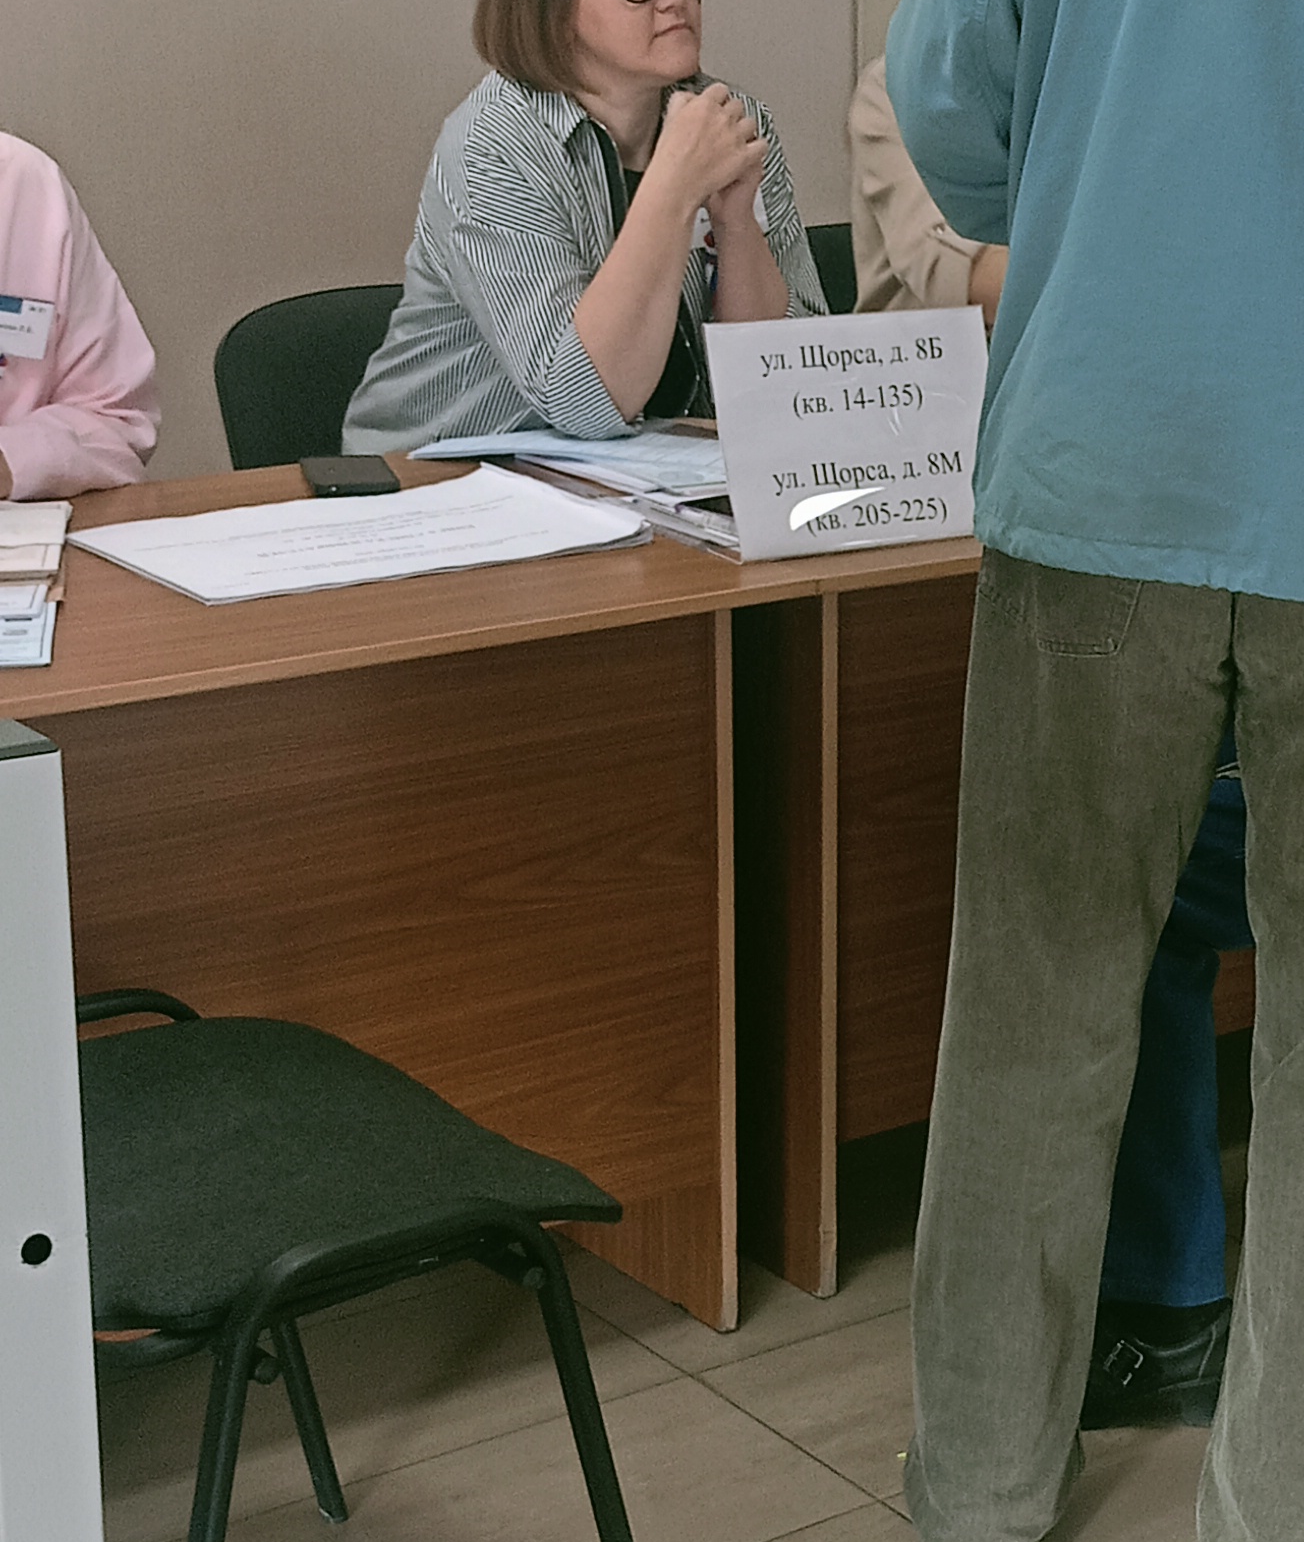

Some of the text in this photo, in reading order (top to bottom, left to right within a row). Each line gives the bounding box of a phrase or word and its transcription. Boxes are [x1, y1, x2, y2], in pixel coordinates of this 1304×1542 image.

[760, 336, 943, 377] ул. Щорса, д. 8Б
[793, 382, 923, 420] (кв. 14-135)
[772, 450, 963, 496] ул. Щорса, д. 8М
[852, 497, 947, 528] 205-225)
